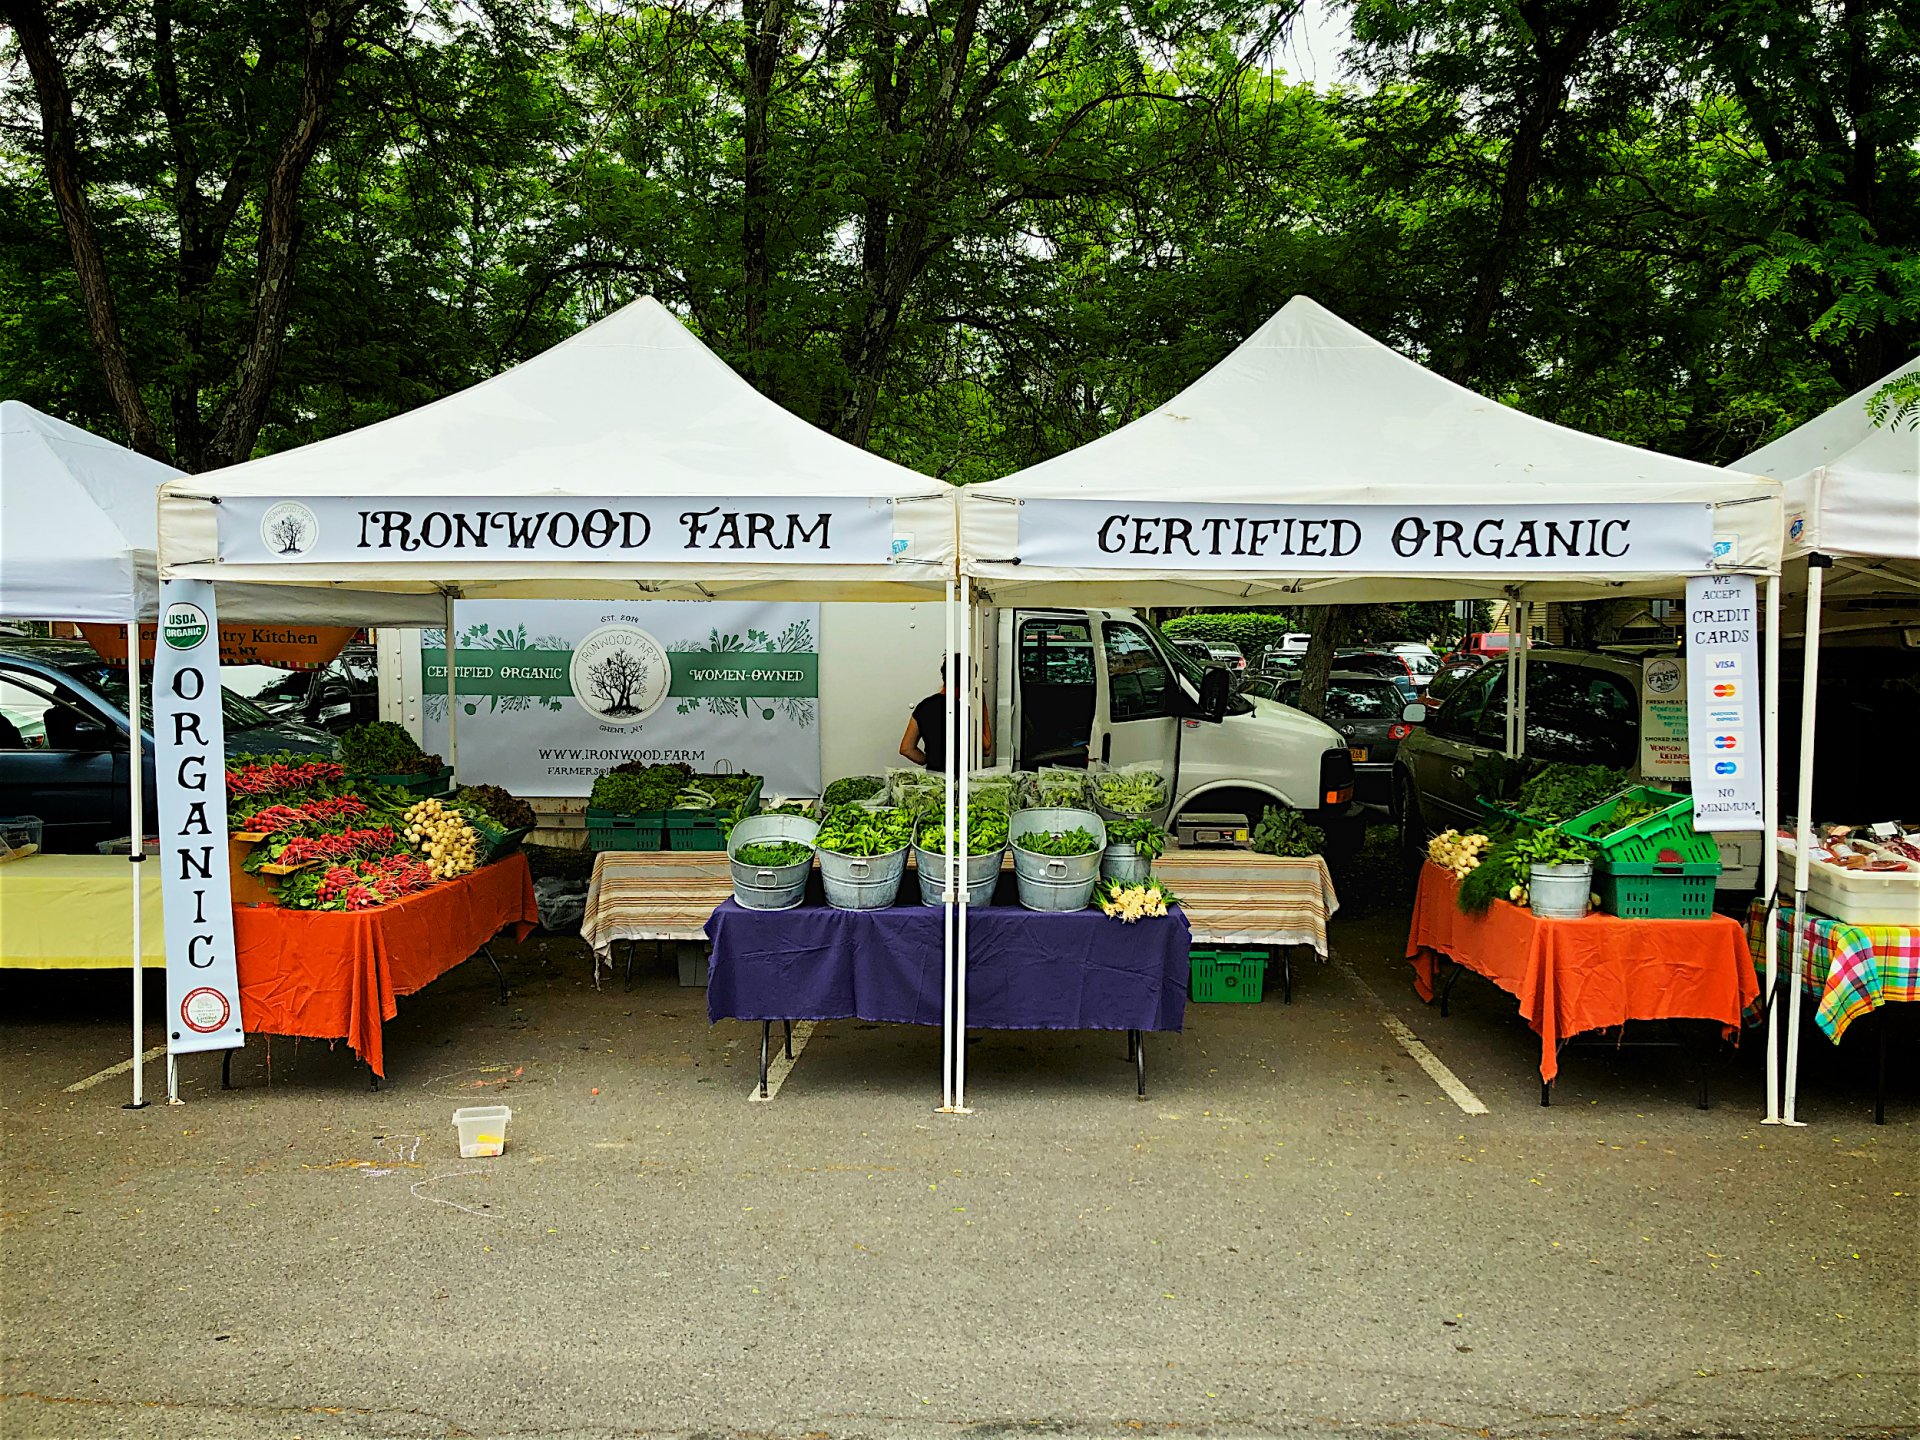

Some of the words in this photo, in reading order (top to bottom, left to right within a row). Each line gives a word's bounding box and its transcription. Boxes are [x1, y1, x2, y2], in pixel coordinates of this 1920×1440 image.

[357, 508, 651, 551] IRONWOOD
[679, 506, 832, 550] FARM
[1097, 514, 1362, 557] CERTIFIED
[1391, 516, 1631, 559] ORGANIC
[1712, 575, 1731, 584] WE
[1702, 589, 1741, 600] ACCEPT
[169, 613, 197, 625] USDA
[600, 614, 617, 623] EST.
[1692, 608, 1750, 623] CREDIT
[166, 626, 202, 638] ORGANIC
[252, 628, 318, 645] Kitchen
[1695, 629, 1750, 644] CARDS
[238, 646, 258, 656] NY
[580, 634, 632, 663] IRONWOOD
[633, 638, 660, 664] FARM
[1714, 660, 1736, 668] VISA
[500, 666, 562, 679] ORGANIC
[689, 668, 804, 682] WOMEN-OWNED
[1648, 673, 1679, 685] FARM
[599, 723, 627, 735] GHENT,
[630, 724, 644, 734] NY
[1650, 743, 1681, 751] VENISON
[538, 749, 705, 761] WWW.IRONWOOD.FARM
[1718, 788, 1735, 797] NO
[1700, 801, 1756, 812] MINIMUM
[170, 667, 215, 968] ORGANIC
